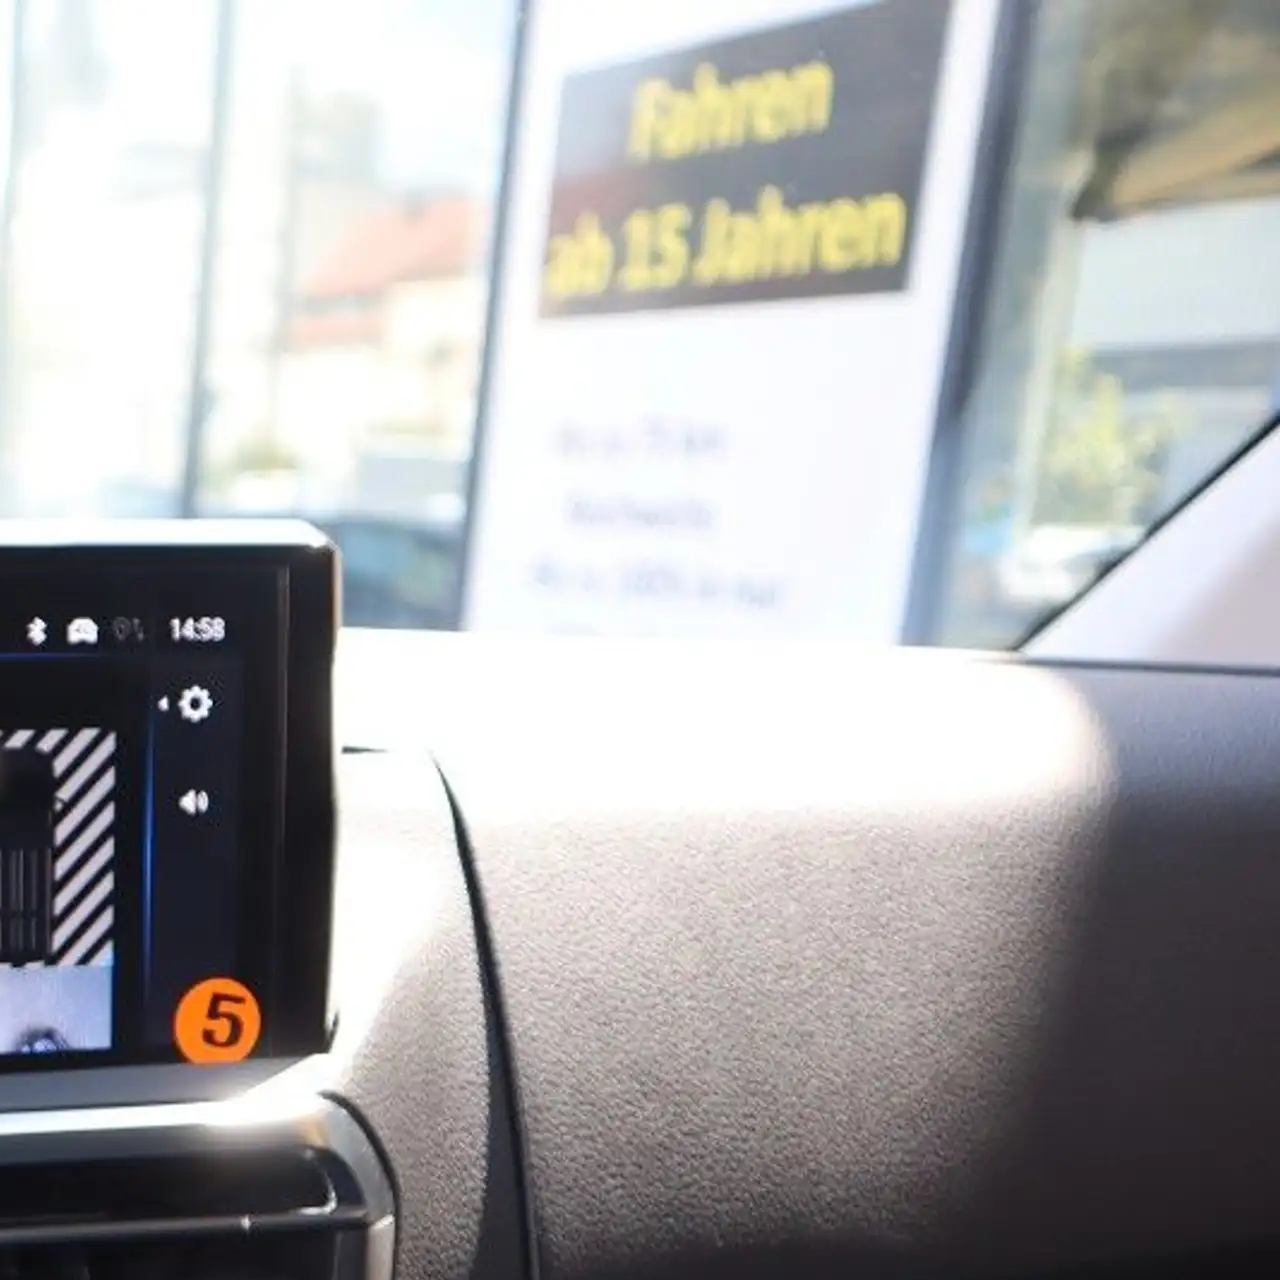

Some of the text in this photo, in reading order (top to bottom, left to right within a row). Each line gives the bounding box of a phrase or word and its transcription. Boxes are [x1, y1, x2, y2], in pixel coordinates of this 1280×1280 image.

[630, 62, 834, 164] Fahren
[542, 184, 906, 300] ab 15 Jahren
[202, 991, 246, 1048] 5
